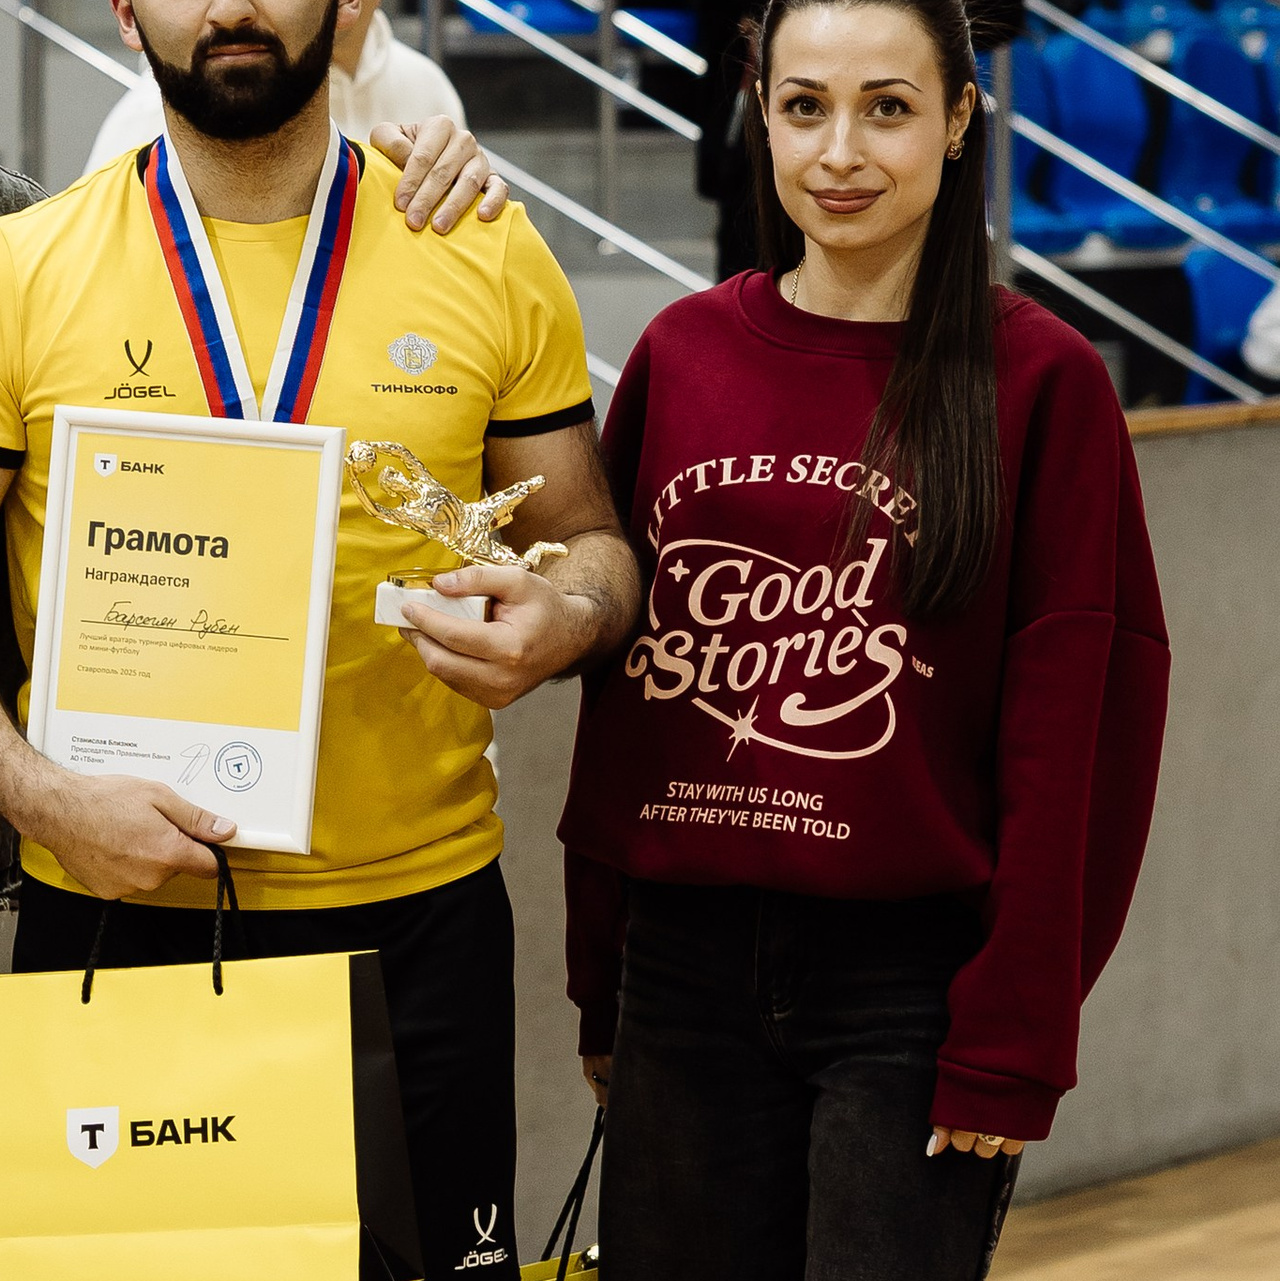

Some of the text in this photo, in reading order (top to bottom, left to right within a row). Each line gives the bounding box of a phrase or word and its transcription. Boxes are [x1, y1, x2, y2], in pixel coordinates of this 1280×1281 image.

[104, 383, 176, 400] JÖGEL
[371, 384, 458, 396] ТИНЬКОФФ
[120, 461, 165, 475] БАНК
[647, 455, 776, 554] LITTLE
[87, 520, 230, 559] Грамота
[84, 567, 190, 588] Награждается
[688, 538, 888, 626] Good
[190, 609, 240, 640] Рубен
[78, 643, 141, 656] по мини-футболу
[79, 632, 238, 653] Лучший вратарь турнира цифровых лидеров
[76, 664, 151, 679] Ставрополь 2025 год
[625, 606, 908, 726] Stories
[71, 735, 107, 746] Станислав
[70, 745, 171, 761] Председатель Правления Банка
[666, 781, 824, 812] STAY WITH US LONG
[639, 804, 851, 840] AFTER THEY'VE BEEN TOLD
[130, 1115, 237, 1147] БАНК
